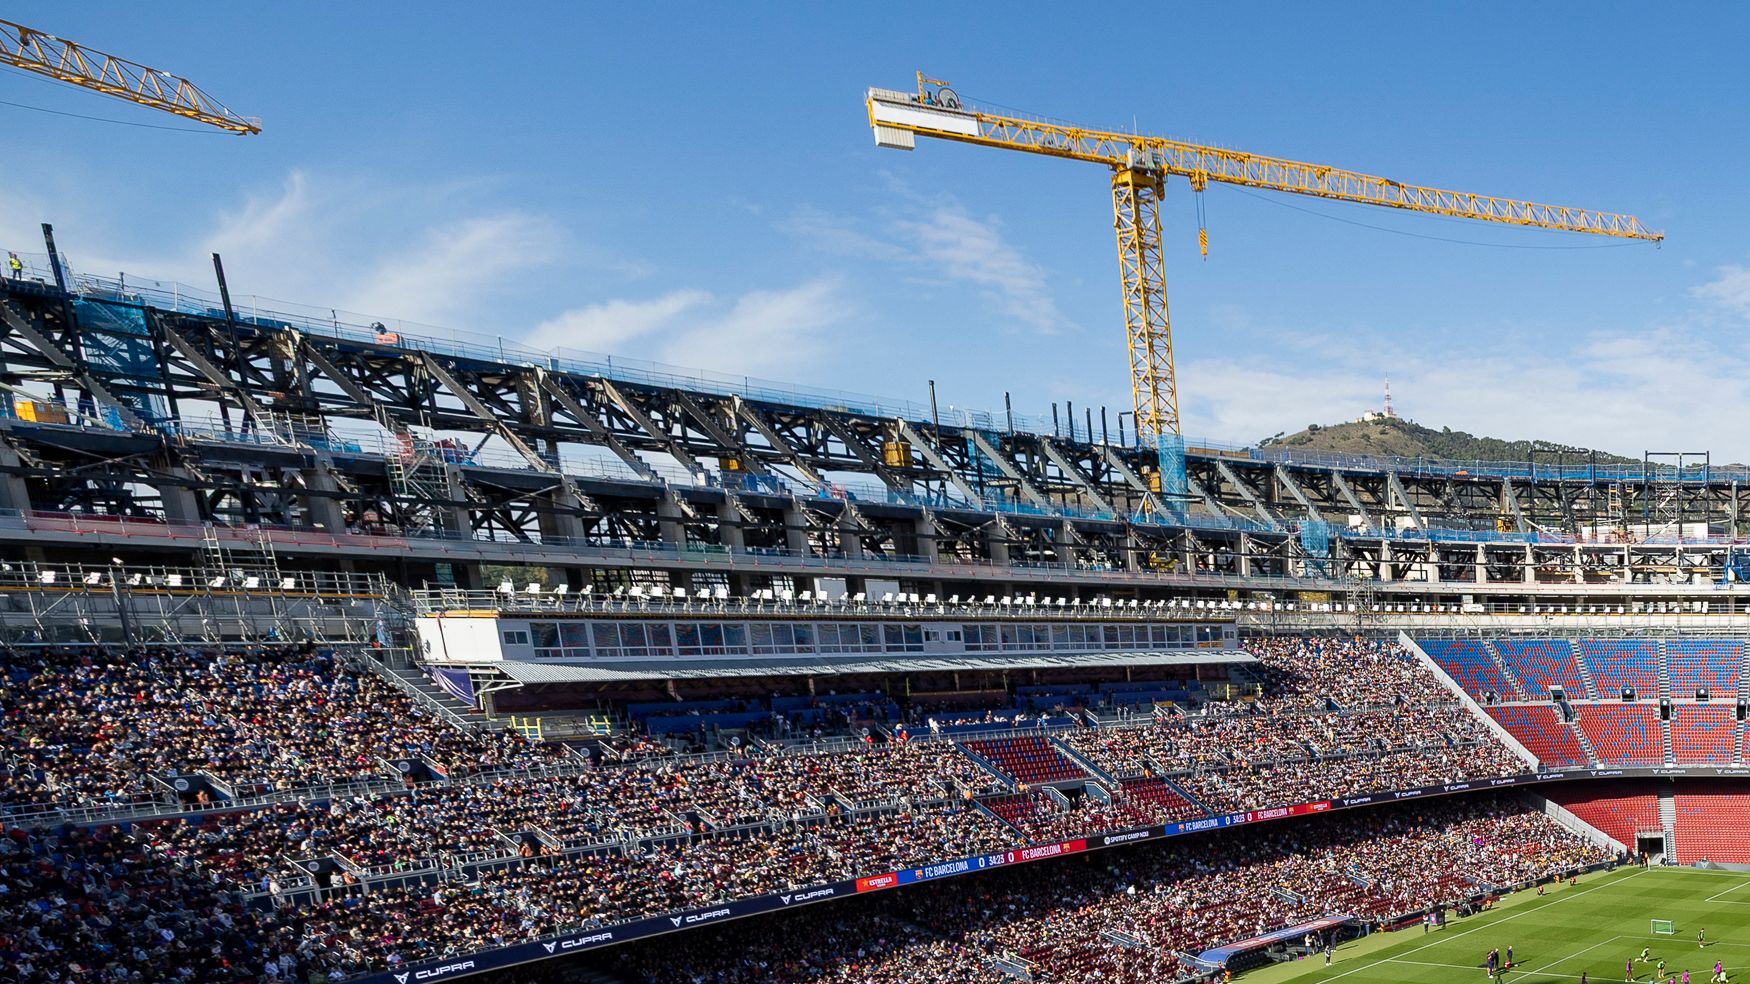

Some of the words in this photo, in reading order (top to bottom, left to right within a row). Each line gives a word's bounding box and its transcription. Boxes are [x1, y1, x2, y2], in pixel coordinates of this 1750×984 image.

[1193, 818, 1218, 830] BARCELONA
[1264, 807, 1287, 819] BARCELONA
[1110, 834, 1127, 843] SPOTIFY
[1127, 832, 1140, 841] CAMP
[925, 867, 934, 877] FC
[934, 861, 969, 876] BARCELONA
[978, 857, 985, 868] 0
[989, 854, 1005, 866] 34:23
[1008, 852, 1014, 863] 0
[1022, 849, 1030, 859] FC
[1030, 844, 1061, 858] BARCELONA
[794, 888, 834, 901] CUPRA
[686, 908, 730, 923] CUPRA
[561, 932, 612, 949] CUPRA
[415, 960, 475, 979] CUPRA
